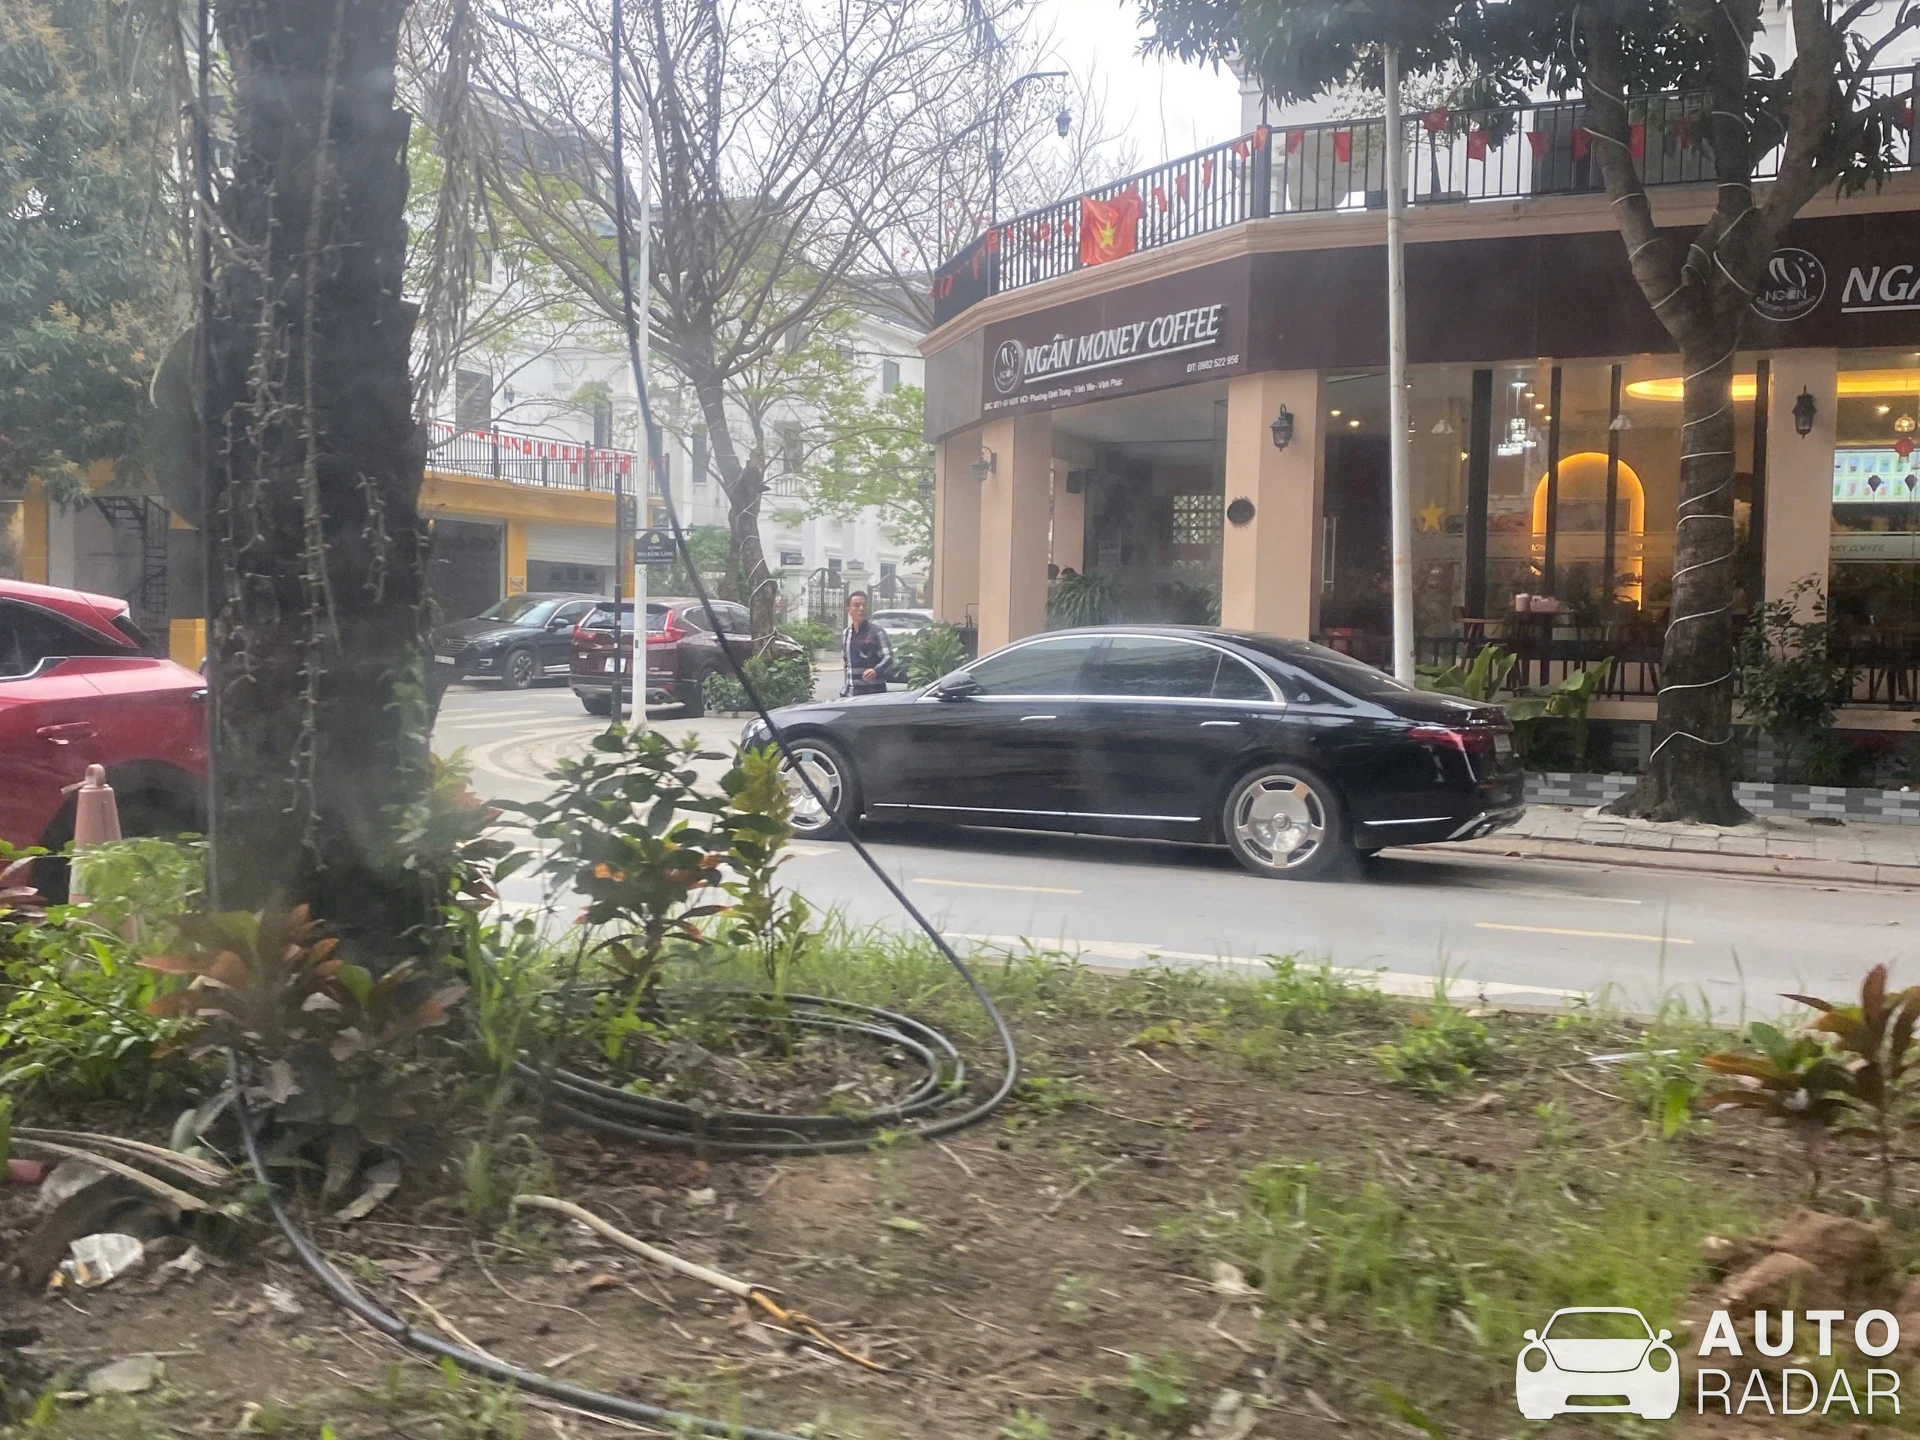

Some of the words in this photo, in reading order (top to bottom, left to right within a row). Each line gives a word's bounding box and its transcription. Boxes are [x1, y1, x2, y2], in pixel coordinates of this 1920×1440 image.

[1024, 333, 1075, 375] NGÂN
[1076, 321, 1146, 364] MONEY
[1148, 303, 1222, 348] COFFEE
